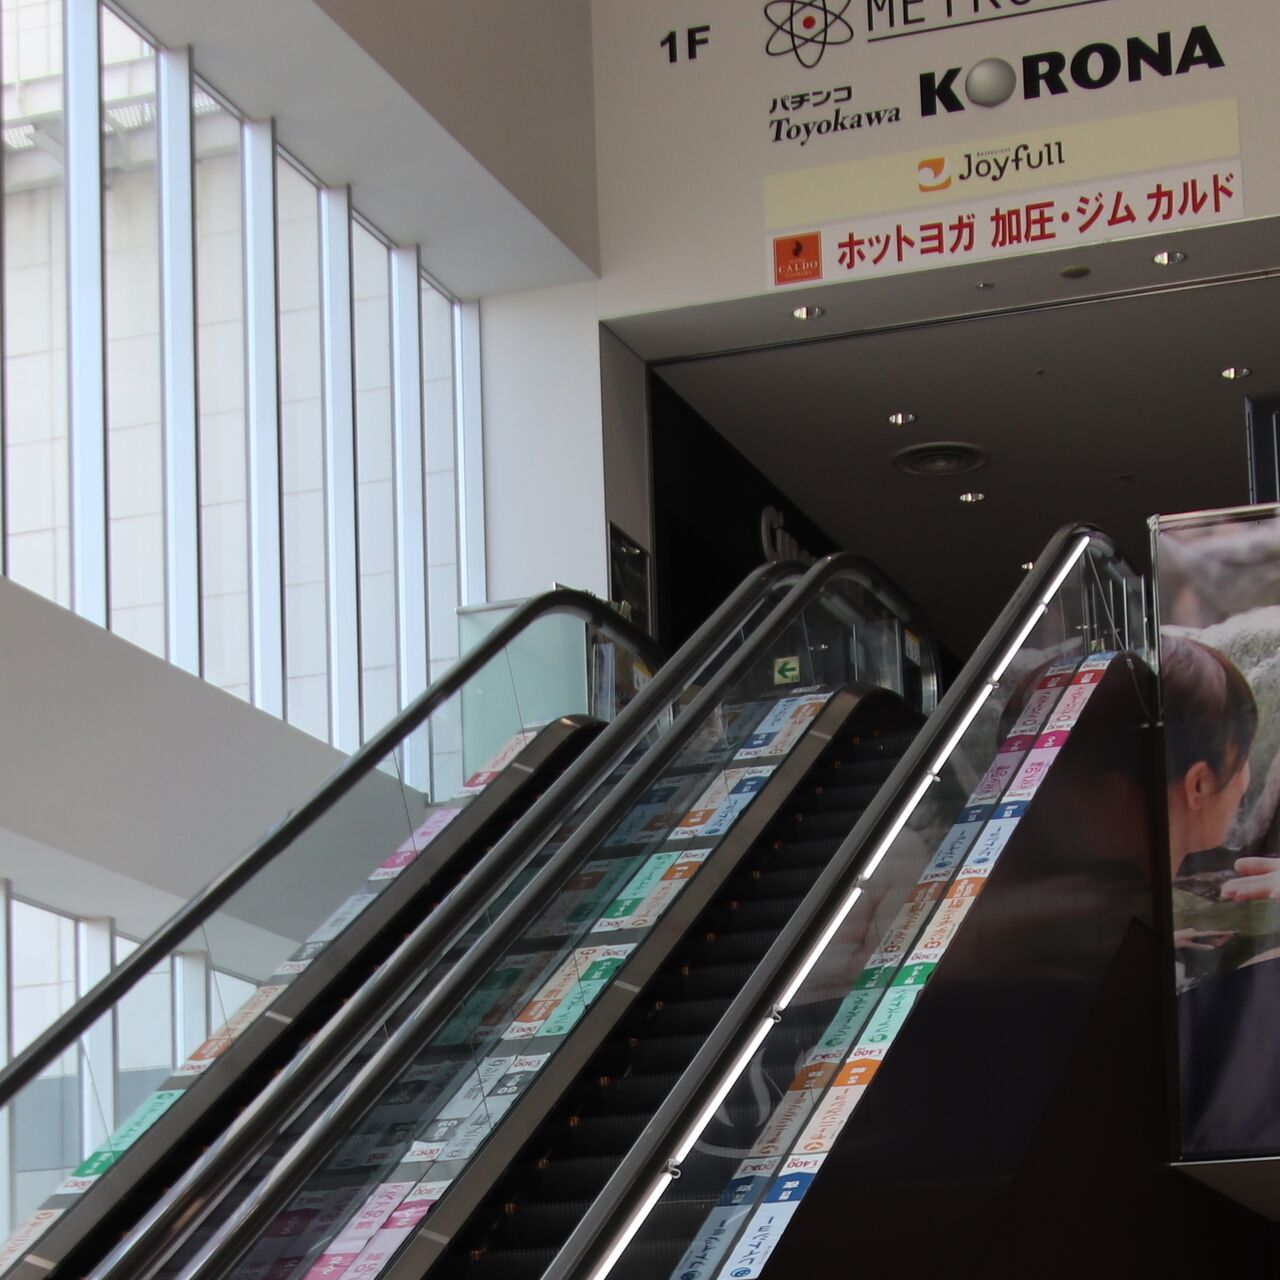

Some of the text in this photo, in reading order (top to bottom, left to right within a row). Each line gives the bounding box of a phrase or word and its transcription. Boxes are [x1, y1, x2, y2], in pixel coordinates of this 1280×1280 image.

[660, 25, 711, 64] 1F
[919, 24, 1225, 117] KORONA
[769, 85, 853, 114] パチンコ
[769, 106, 902, 146] Toyokawa
[958, 141, 1066, 182] Joyfull
[838, 173, 1235, 270] ホットヨガ 加圧・ジム カルド
